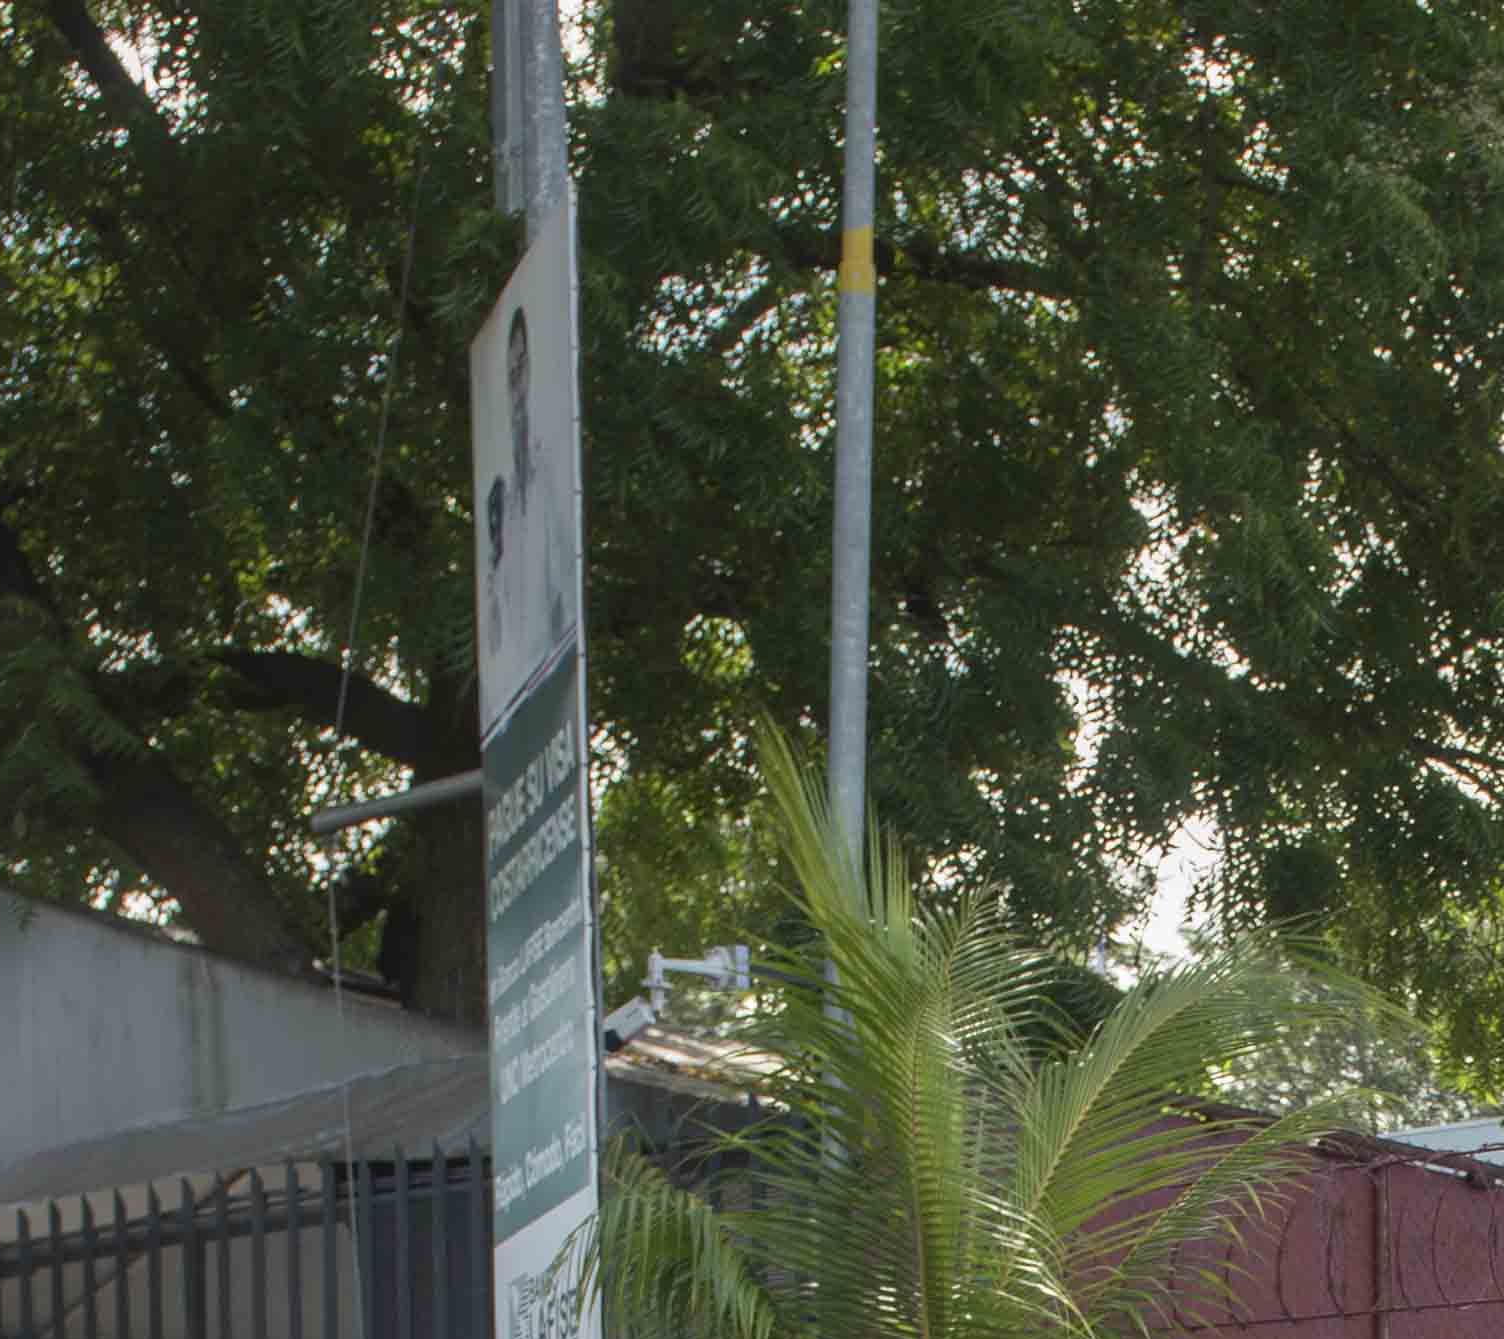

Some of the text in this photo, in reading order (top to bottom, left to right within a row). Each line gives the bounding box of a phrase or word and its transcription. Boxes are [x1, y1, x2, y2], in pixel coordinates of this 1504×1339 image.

[488, 719, 575, 858] PAGUE SU VISA
[489, 793, 575, 922] COSTARRICENSE
